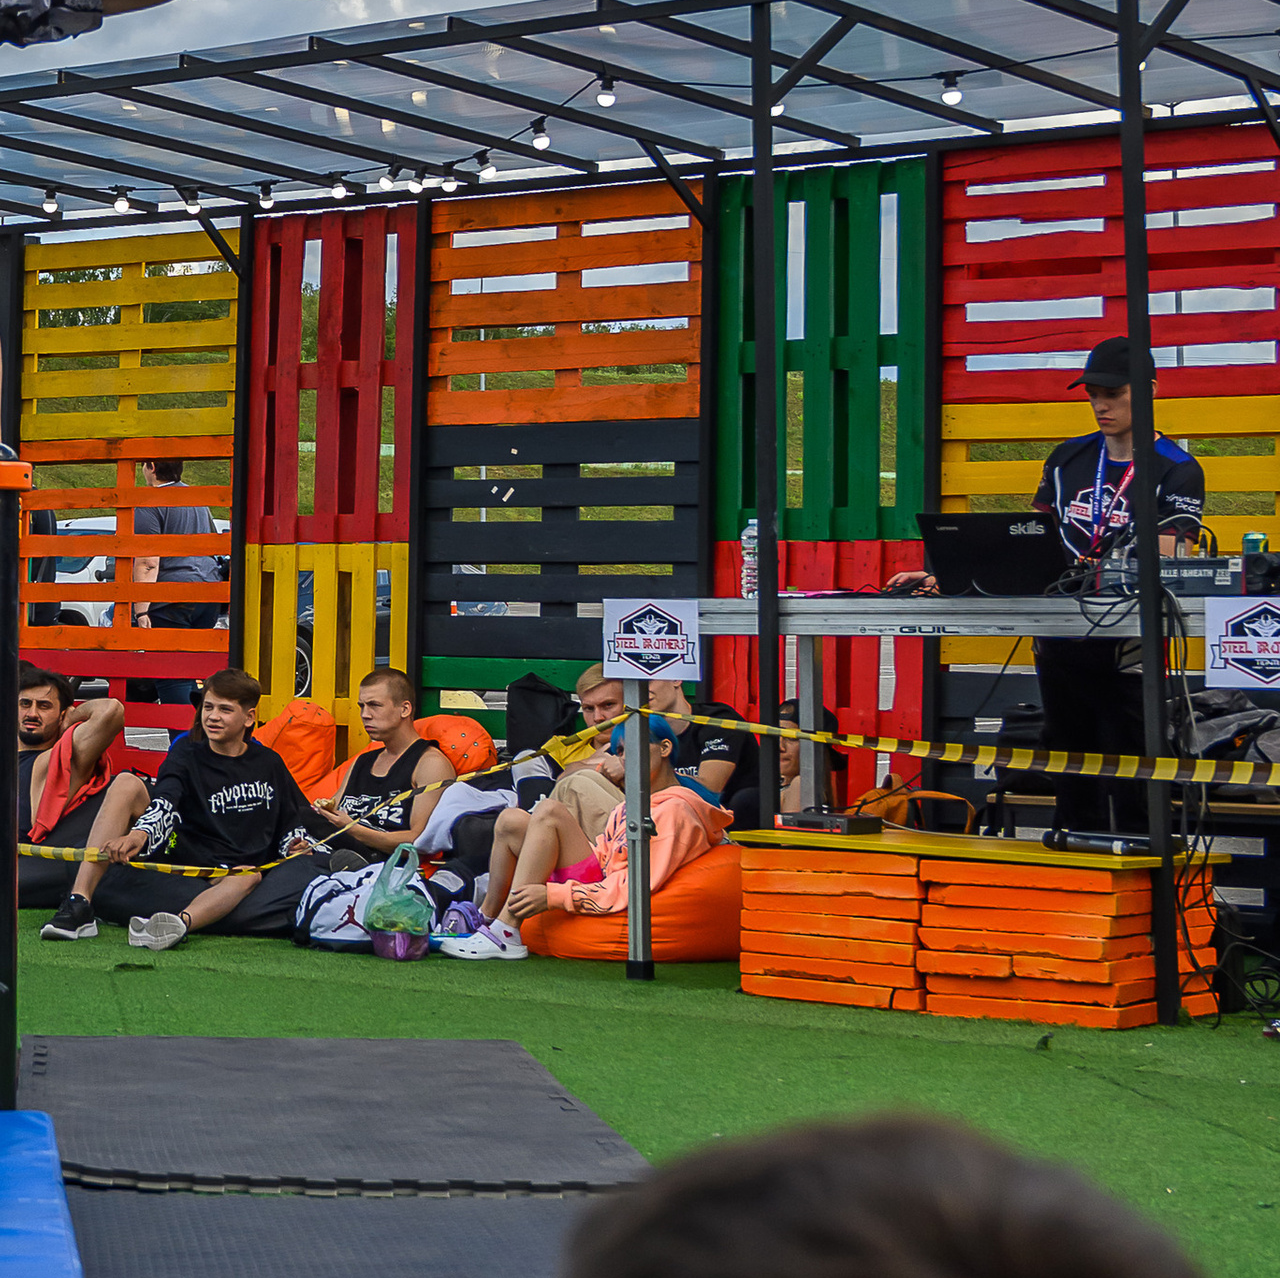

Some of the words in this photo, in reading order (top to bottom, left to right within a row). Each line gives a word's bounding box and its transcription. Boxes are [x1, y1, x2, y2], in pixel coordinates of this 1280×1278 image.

[1009, 521, 1045, 535] skills
[899, 626, 960, 634] GUIL
[616, 637, 640, 650] STEEL
[642, 637, 686, 650] BROTHERS
[1221, 641, 1253, 654] STEEL
